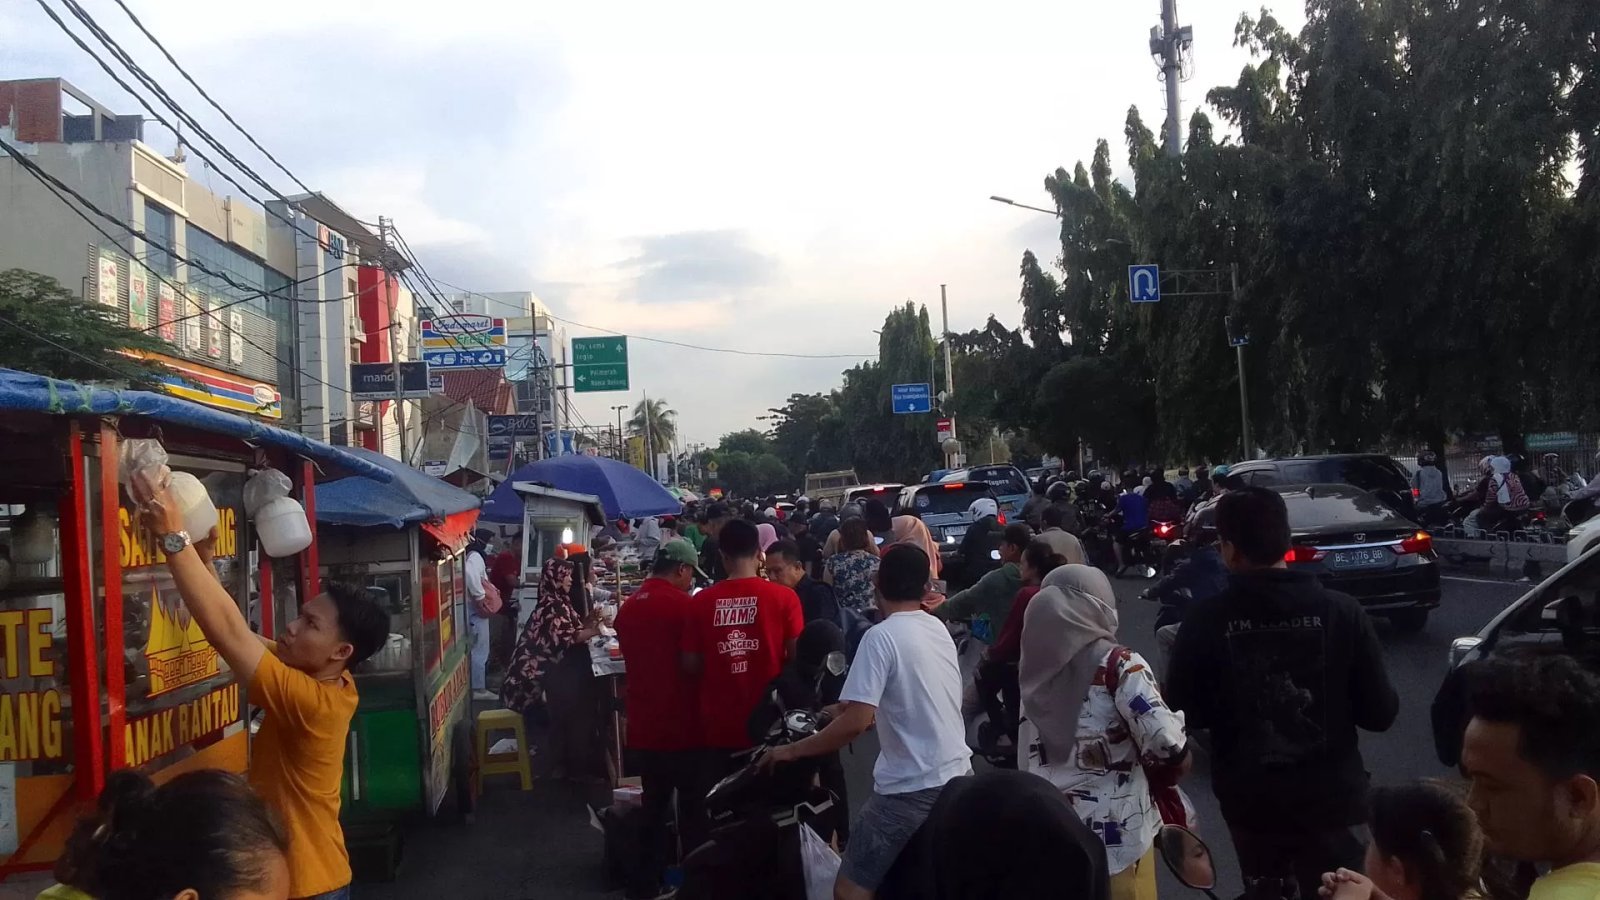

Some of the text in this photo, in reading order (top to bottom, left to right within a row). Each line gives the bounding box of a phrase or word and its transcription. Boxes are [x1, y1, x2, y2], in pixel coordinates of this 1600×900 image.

[363, 372, 396, 383] mand
[733, 597, 757, 606] MAKAN
[713, 606, 757, 626] AYAM?
[717, 639, 759, 654] RANGERS
[125, 682, 239, 767] ANAK RANTAU
